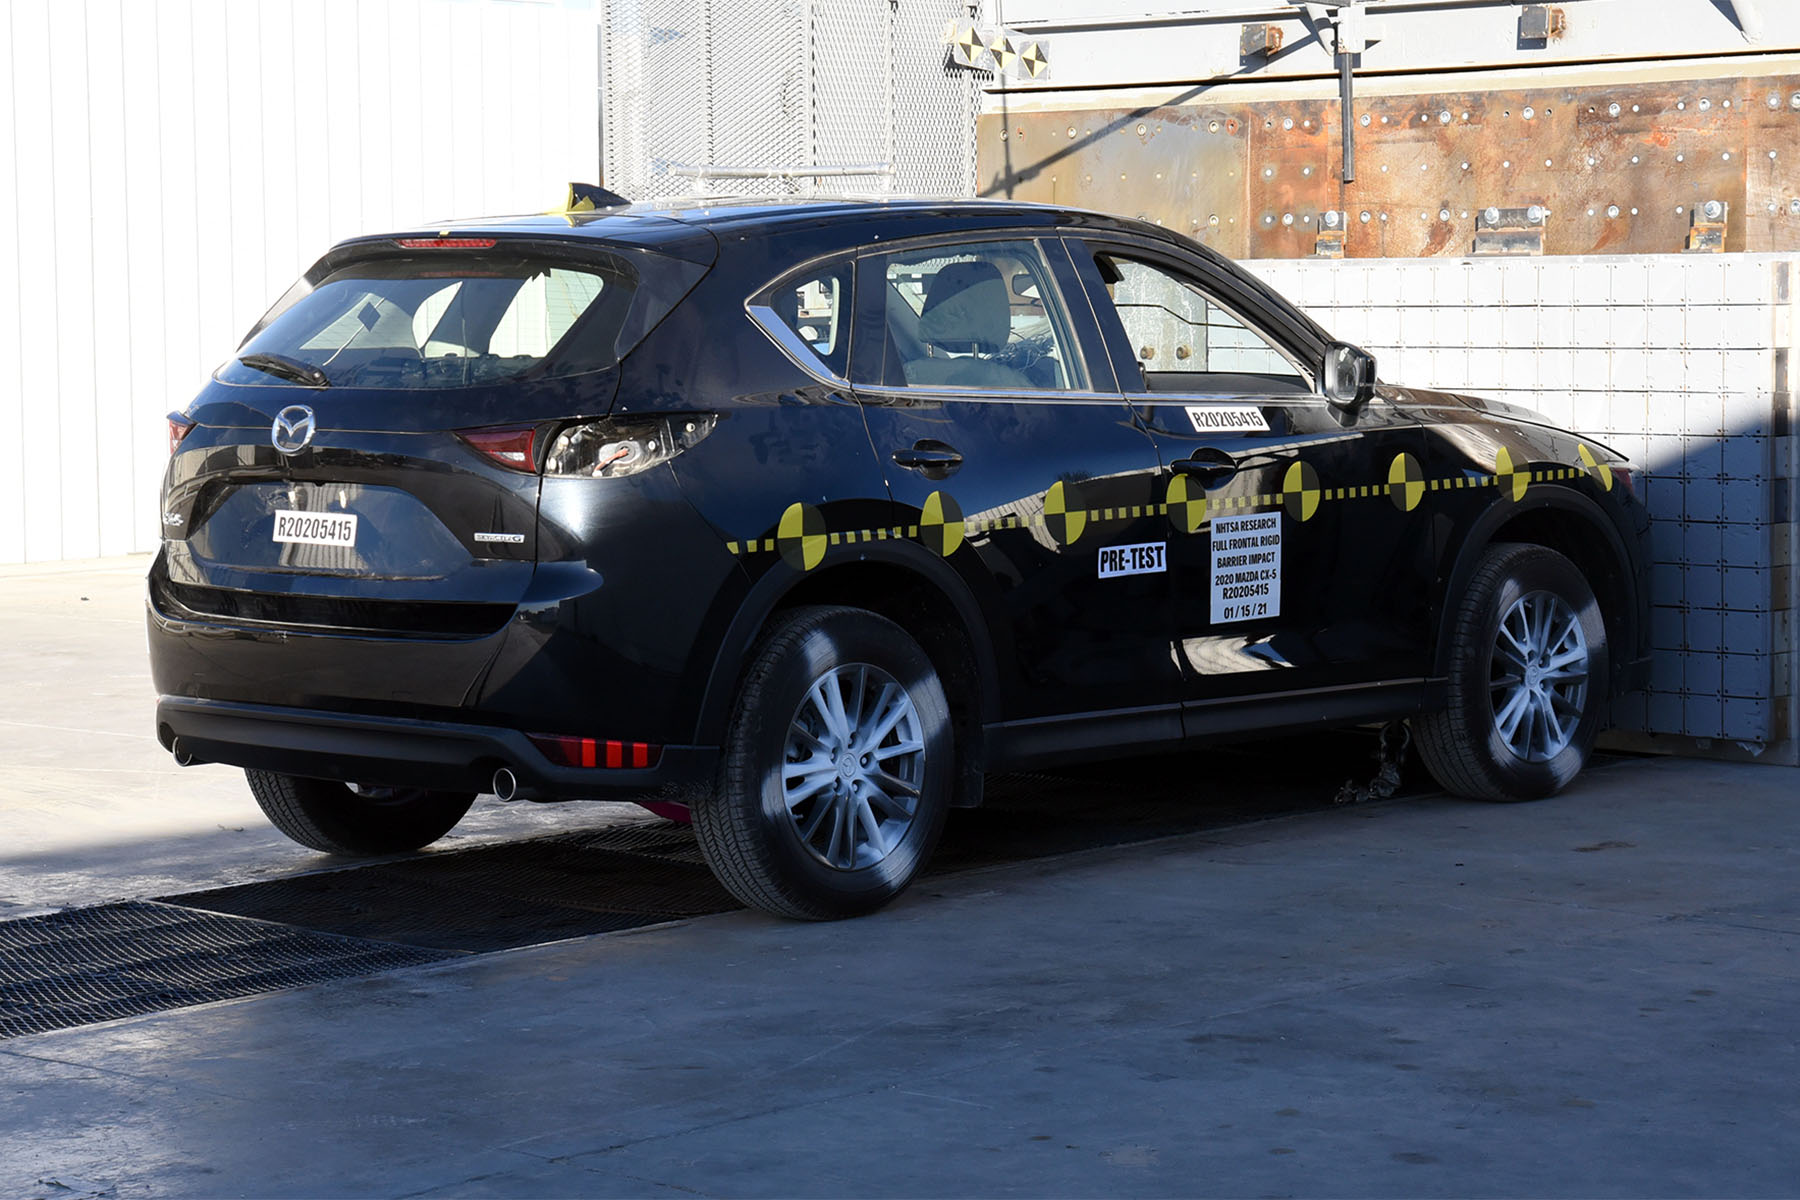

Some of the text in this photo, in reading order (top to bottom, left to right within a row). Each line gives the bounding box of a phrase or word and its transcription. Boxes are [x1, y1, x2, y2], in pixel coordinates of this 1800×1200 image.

[1192, 411, 1264, 428] R20205415
[278, 516, 352, 541] R20205415
[1215, 517, 1277, 534] NHTSA RESEARCH
[1212, 534, 1280, 552] FULL FRONTAL RIGID
[1100, 545, 1164, 573] PRE-TEST
[1217, 551, 1276, 569] BARRIER IMPACT
[1215, 568, 1277, 586] 2020 MAZDA CX-5
[1222, 583, 1269, 600] R20205415
